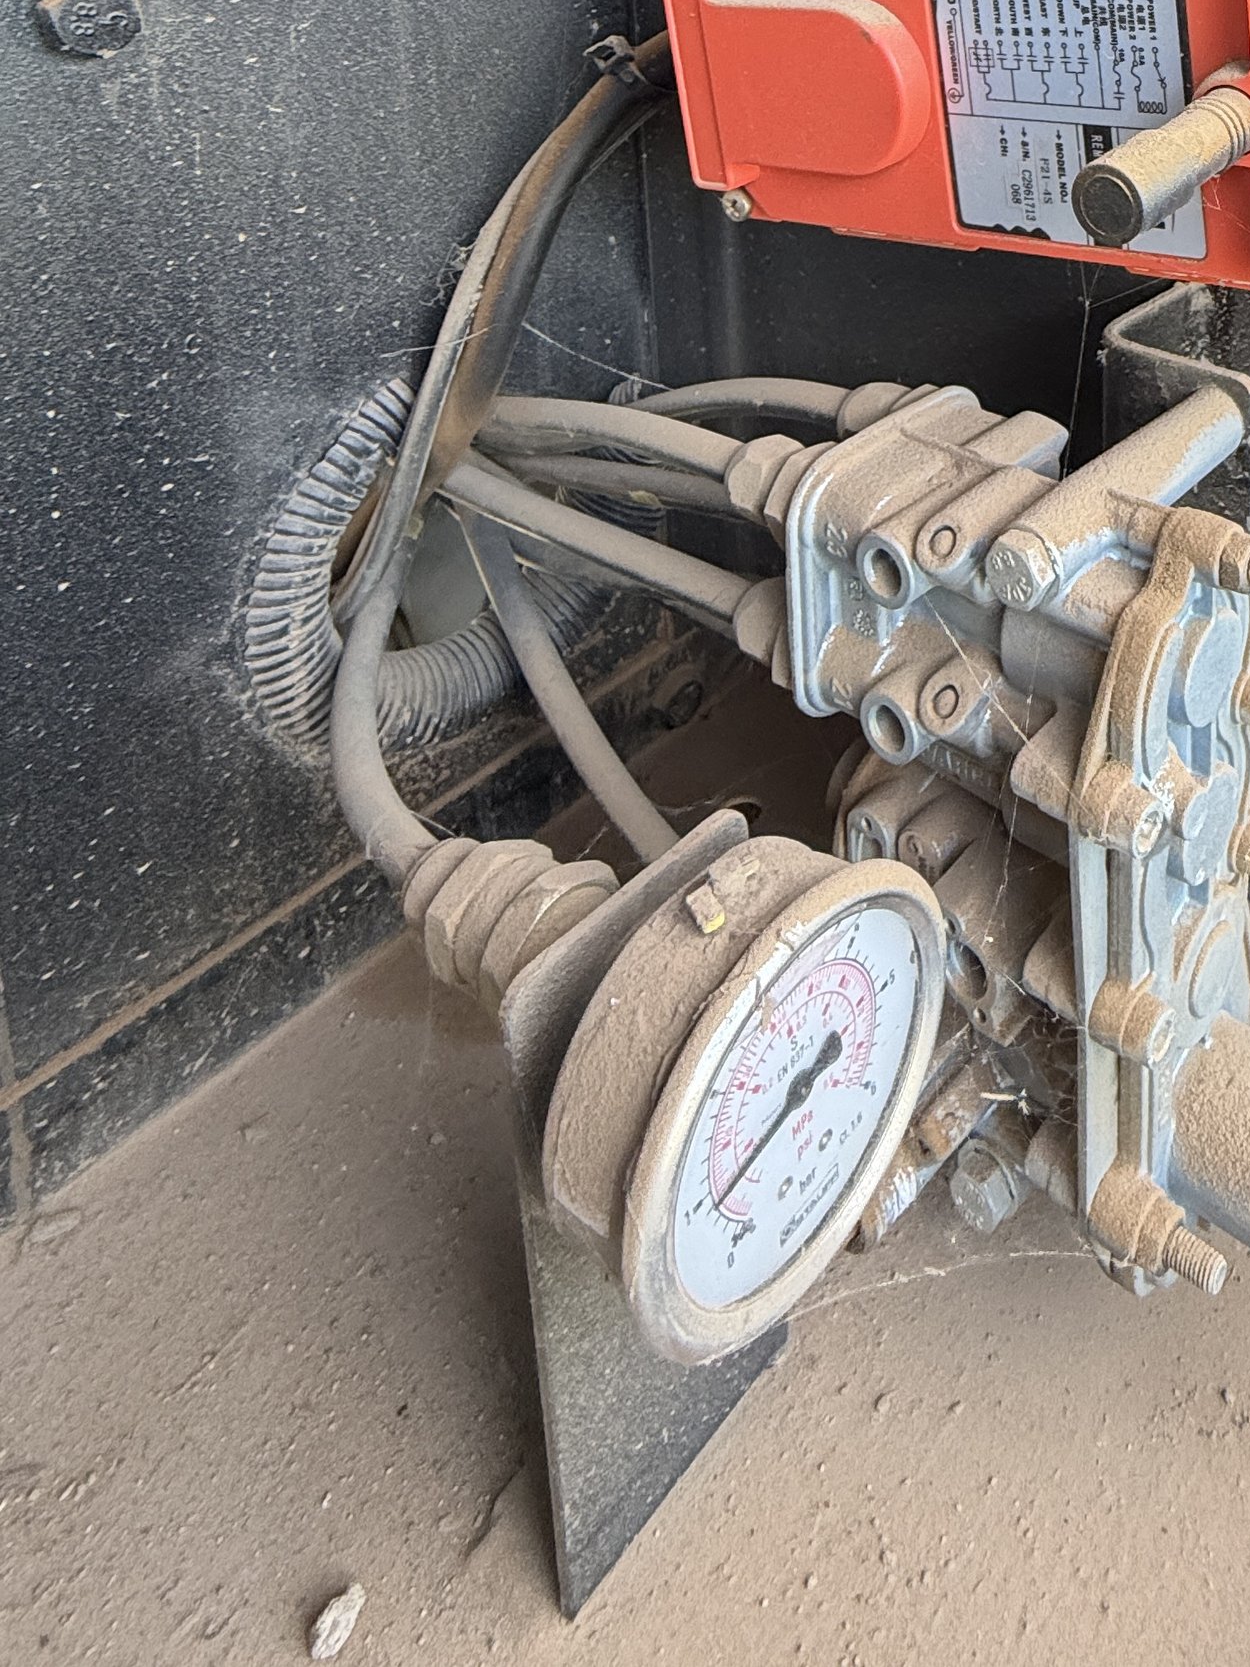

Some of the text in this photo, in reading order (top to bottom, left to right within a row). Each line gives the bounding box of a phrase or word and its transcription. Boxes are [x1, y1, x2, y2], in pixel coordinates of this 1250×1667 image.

[1059, 27, 1068, 37] 下
[1074, 27, 1084, 38] 上
[1055, 142, 1067, 179] MODEL
[1010, 184, 1022, 205] 068
[791, 1035, 798, 1052] S
[777, 1063, 788, 1082] EN
[799, 1166, 817, 1195] bar
